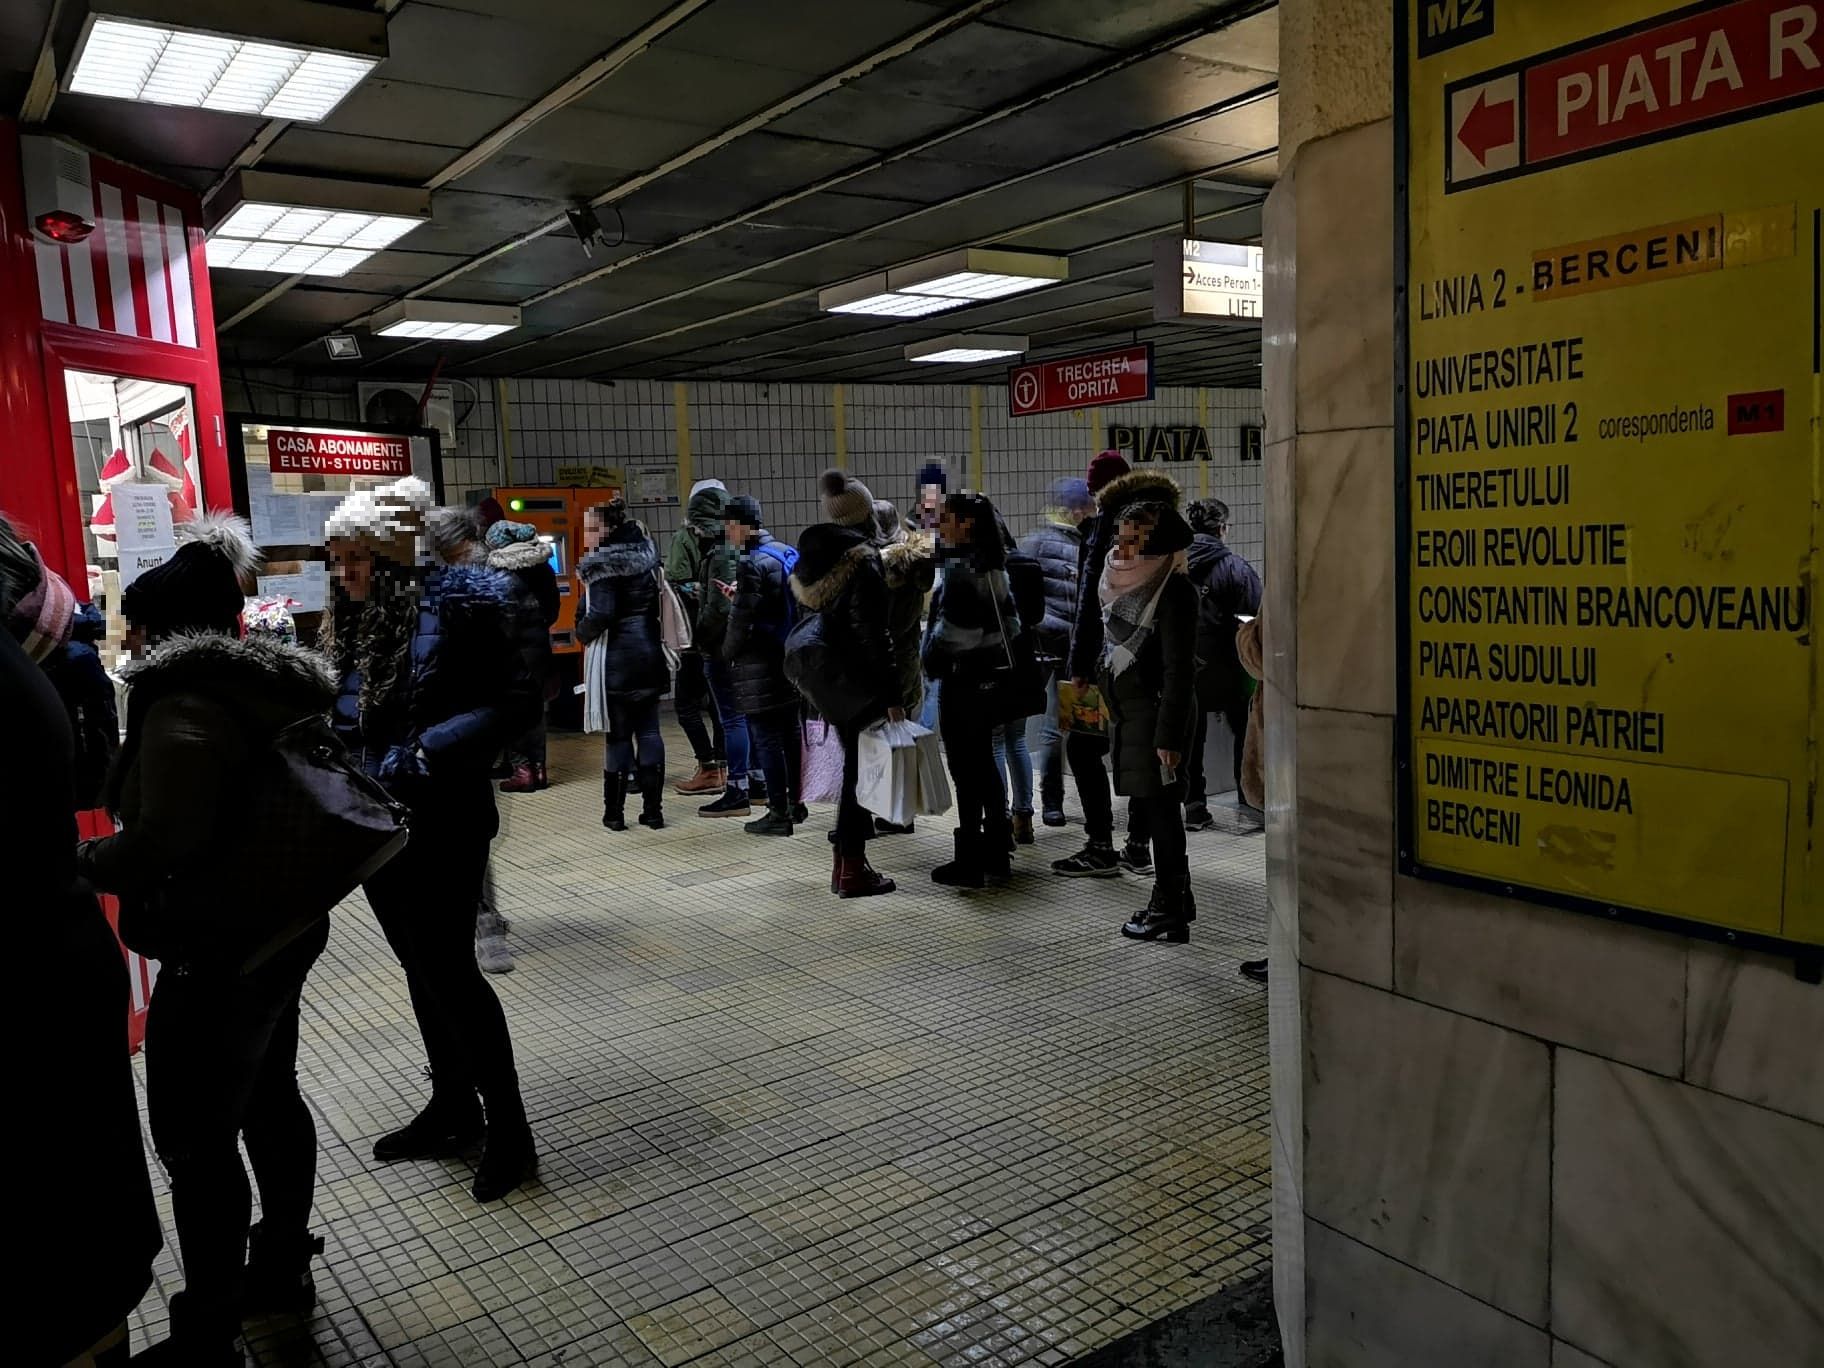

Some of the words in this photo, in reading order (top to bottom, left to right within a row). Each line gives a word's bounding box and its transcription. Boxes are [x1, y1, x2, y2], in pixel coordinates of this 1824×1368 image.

[1427, 0, 1484, 38] M2
[1556, 29, 1744, 137] PIATA
[1183, 239, 1201, 257] M2
[1196, 273, 1222, 288] Acces
[1224, 275, 1250, 290] Peron
[1420, 272, 1484, 321] LINIA
[1492, 269, 1507, 309] 2
[1533, 226, 1717, 292] BERCENI
[1228, 298, 1257, 318] LIFT
[1056, 356, 1131, 383] TRECEREA
[1067, 378, 1119, 400] OPRITA
[1416, 337, 1584, 399] UNIVERSITATE
[276, 436, 316, 453] CASA
[318, 439, 404, 458] ABONAMENTE
[1108, 425, 1214, 462] PIATA
[1416, 412, 1479, 455] PIATA
[1486, 404, 1557, 451] UNIRII
[1562, 402, 1579, 442] 2
[1599, 404, 1714, 443] corespondenta
[280, 455, 404, 471] ELEVI-STUDENTI
[1416, 464, 1570, 511] TINERETULUI
[1416, 529, 1477, 568] EROII
[1484, 524, 1627, 567] REVOLUTIE
[1418, 586, 1568, 626] CONSTANTIN
[1576, 586, 1807, 632] BRANCOVEANU
[1419, 640, 1483, 681] PIATA
[1488, 643, 1597, 687] SUDULUI
[1420, 696, 1558, 743] APARATORII
[1566, 706, 1664, 754] PATRIEI
[1425, 753, 1519, 797] DIMITRIE
[1526, 765, 1633, 815] LEONIDA
[1426, 799, 1521, 847] BERCENI
